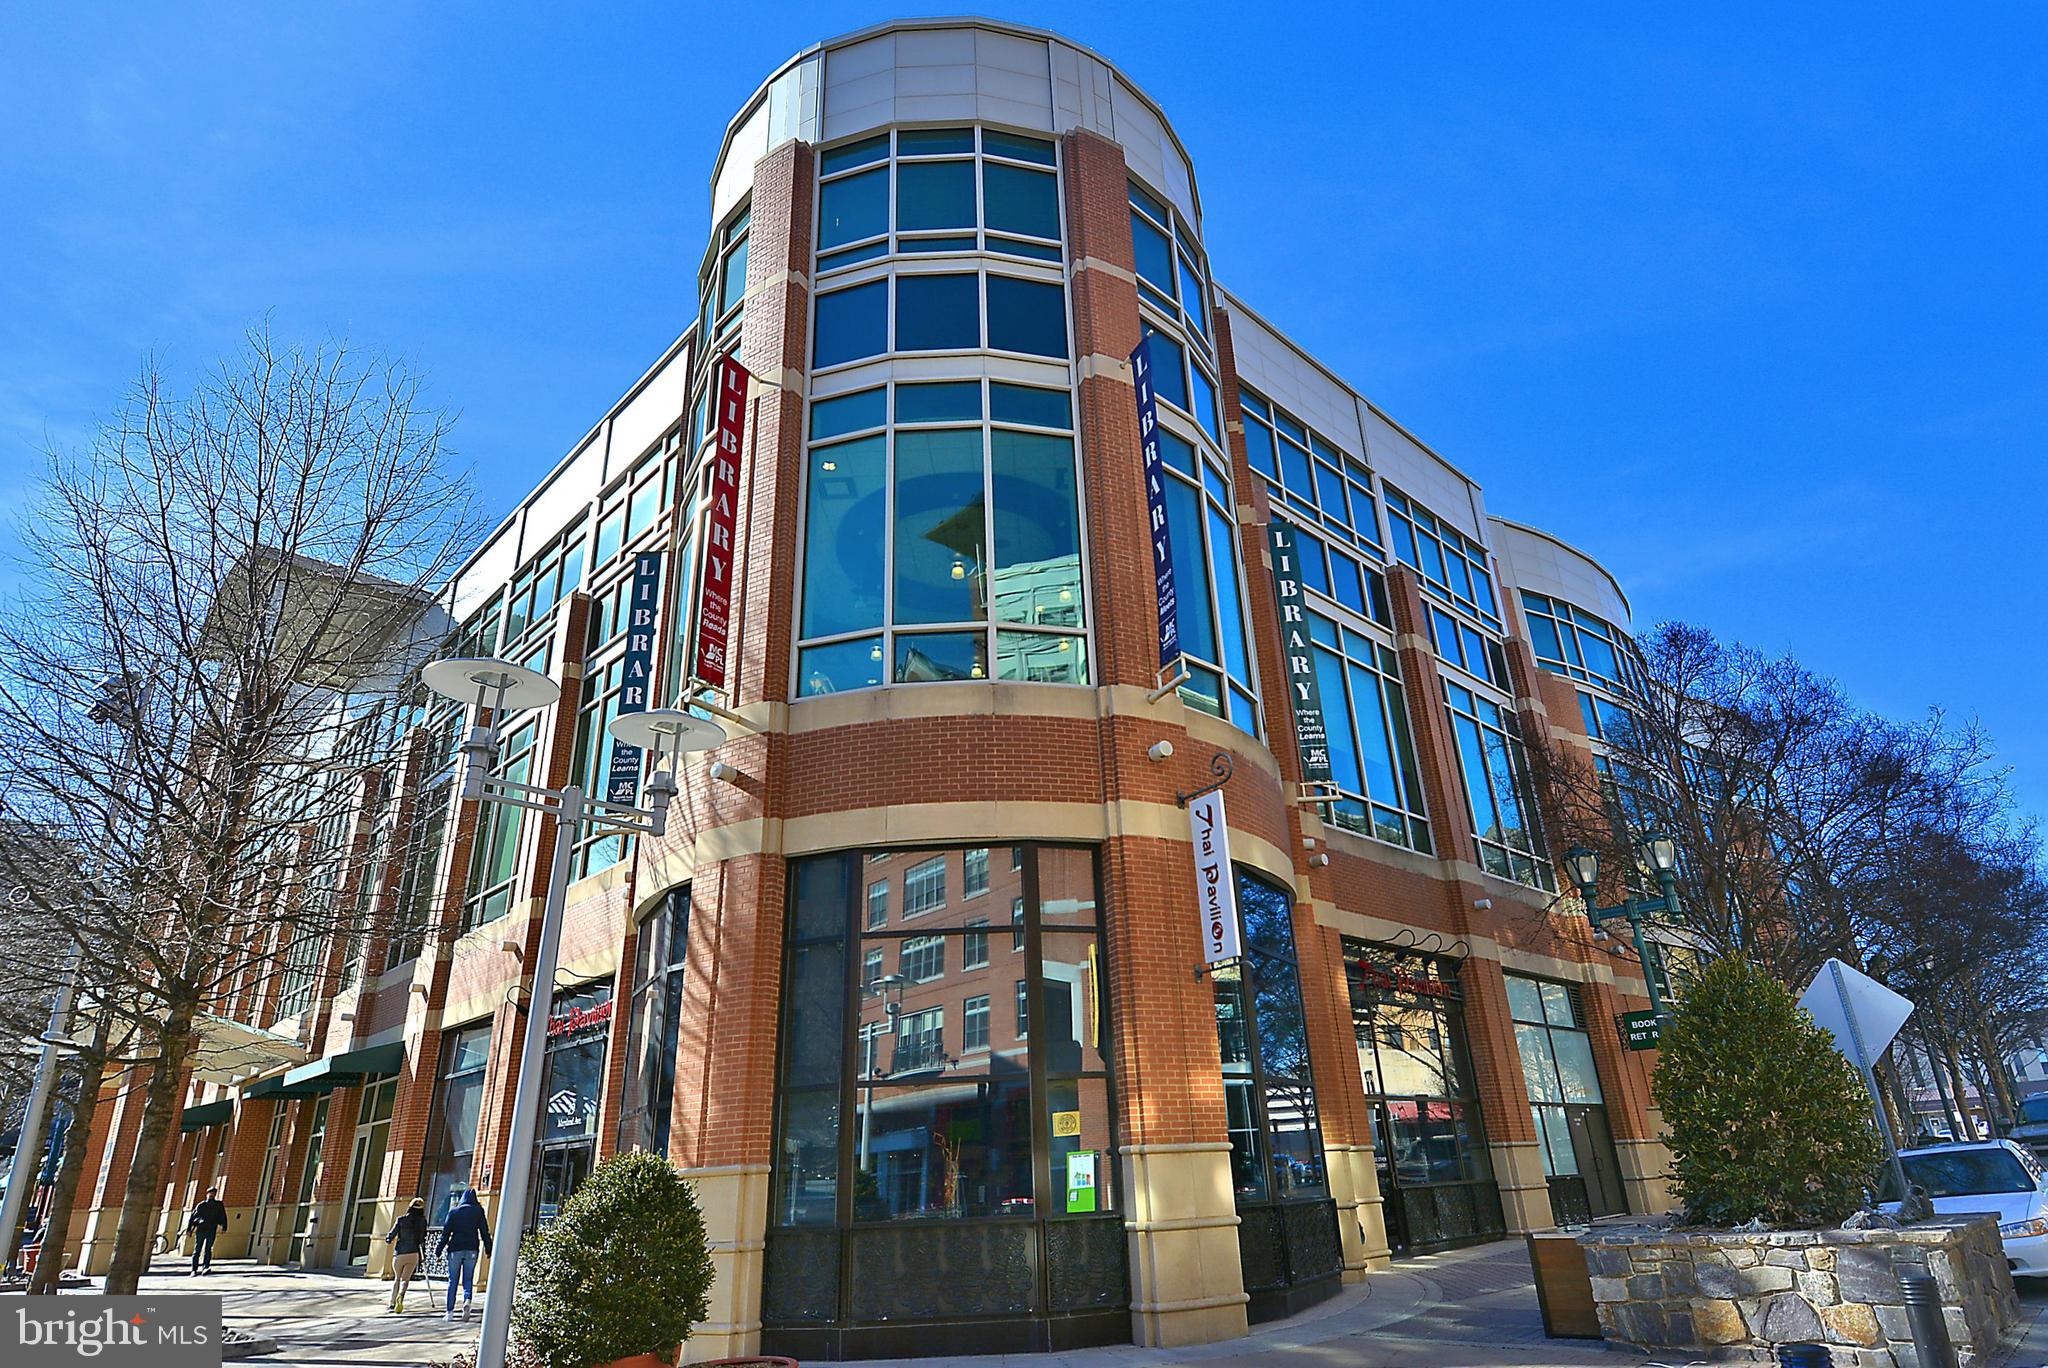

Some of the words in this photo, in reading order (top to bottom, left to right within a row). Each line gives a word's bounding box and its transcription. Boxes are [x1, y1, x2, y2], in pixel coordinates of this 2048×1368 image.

[1136, 354, 1166, 563] LIBRARY
[711, 367, 744, 584] LIBRARY
[705, 587, 728, 606] Where
[709, 600, 721, 612] the
[702, 607, 727, 627] County
[1274, 531, 1311, 701] LIBRARY
[625, 558, 655, 706] LIBRAR
[702, 618, 726, 636] Reads
[1297, 725, 1323, 733] County
[612, 756, 639, 765] County
[1195, 803, 1215, 857] Thai
[1201, 861, 1225, 954] Pavilion
[548, 1014, 565, 1037] hai
[1631, 1019, 1658, 1029] BOOK
[1630, 1030, 1660, 1041] RETR
